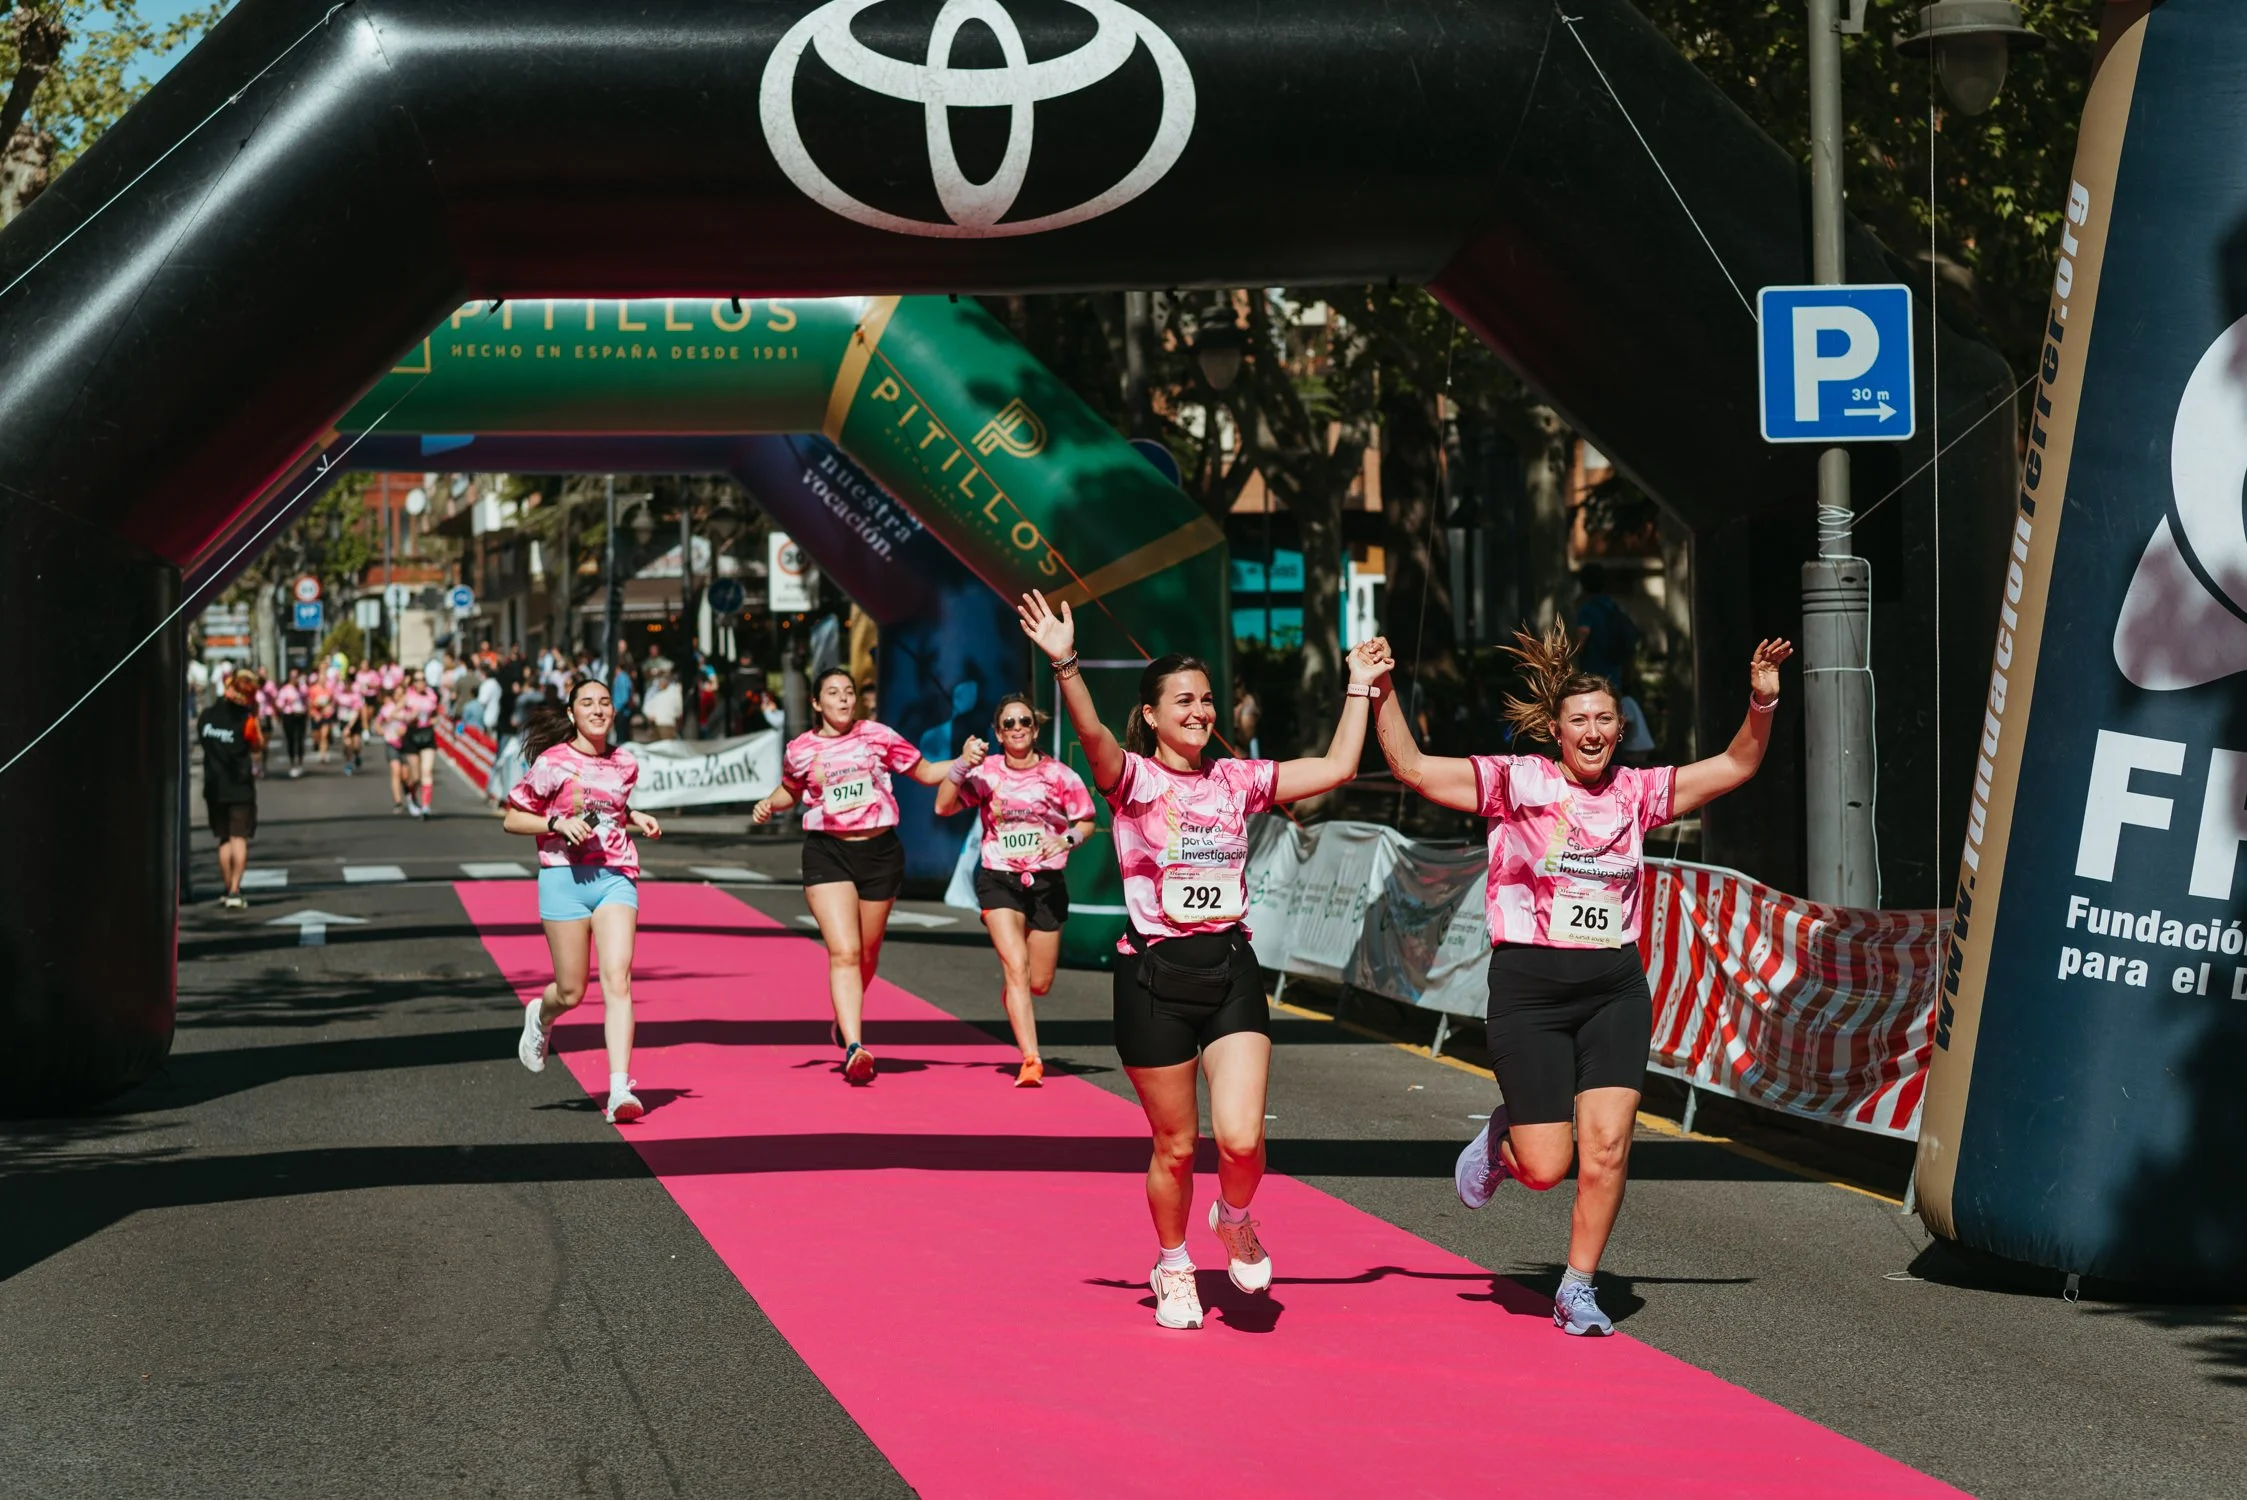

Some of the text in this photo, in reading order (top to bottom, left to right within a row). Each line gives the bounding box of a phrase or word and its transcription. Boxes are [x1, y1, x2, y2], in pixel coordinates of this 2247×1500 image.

[451, 343, 799, 360] HECHO EN ESPAÑA DESDE 1981
[1792, 306, 1880, 422] P
[1851, 388, 1890, 401] 30 m
[871, 376, 1058, 576] PITILLOS
[819, 453, 912, 543] nuestra
[802, 467, 893, 562] vocación.
[824, 766, 857, 778] Carrera
[833, 783, 864, 801] 9747
[1180, 821, 1222, 834] Carrera
[1570, 824, 1581, 838] XI
[1181, 837, 1200, 848] por
[1561, 850, 1582, 862] por
[1182, 886, 1222, 909] 292
[1570, 905, 1609, 930] 265
[2066, 895, 2247, 956] Fundació
[2058, 946, 2149, 987] para
[2172, 962, 2211, 996] el
